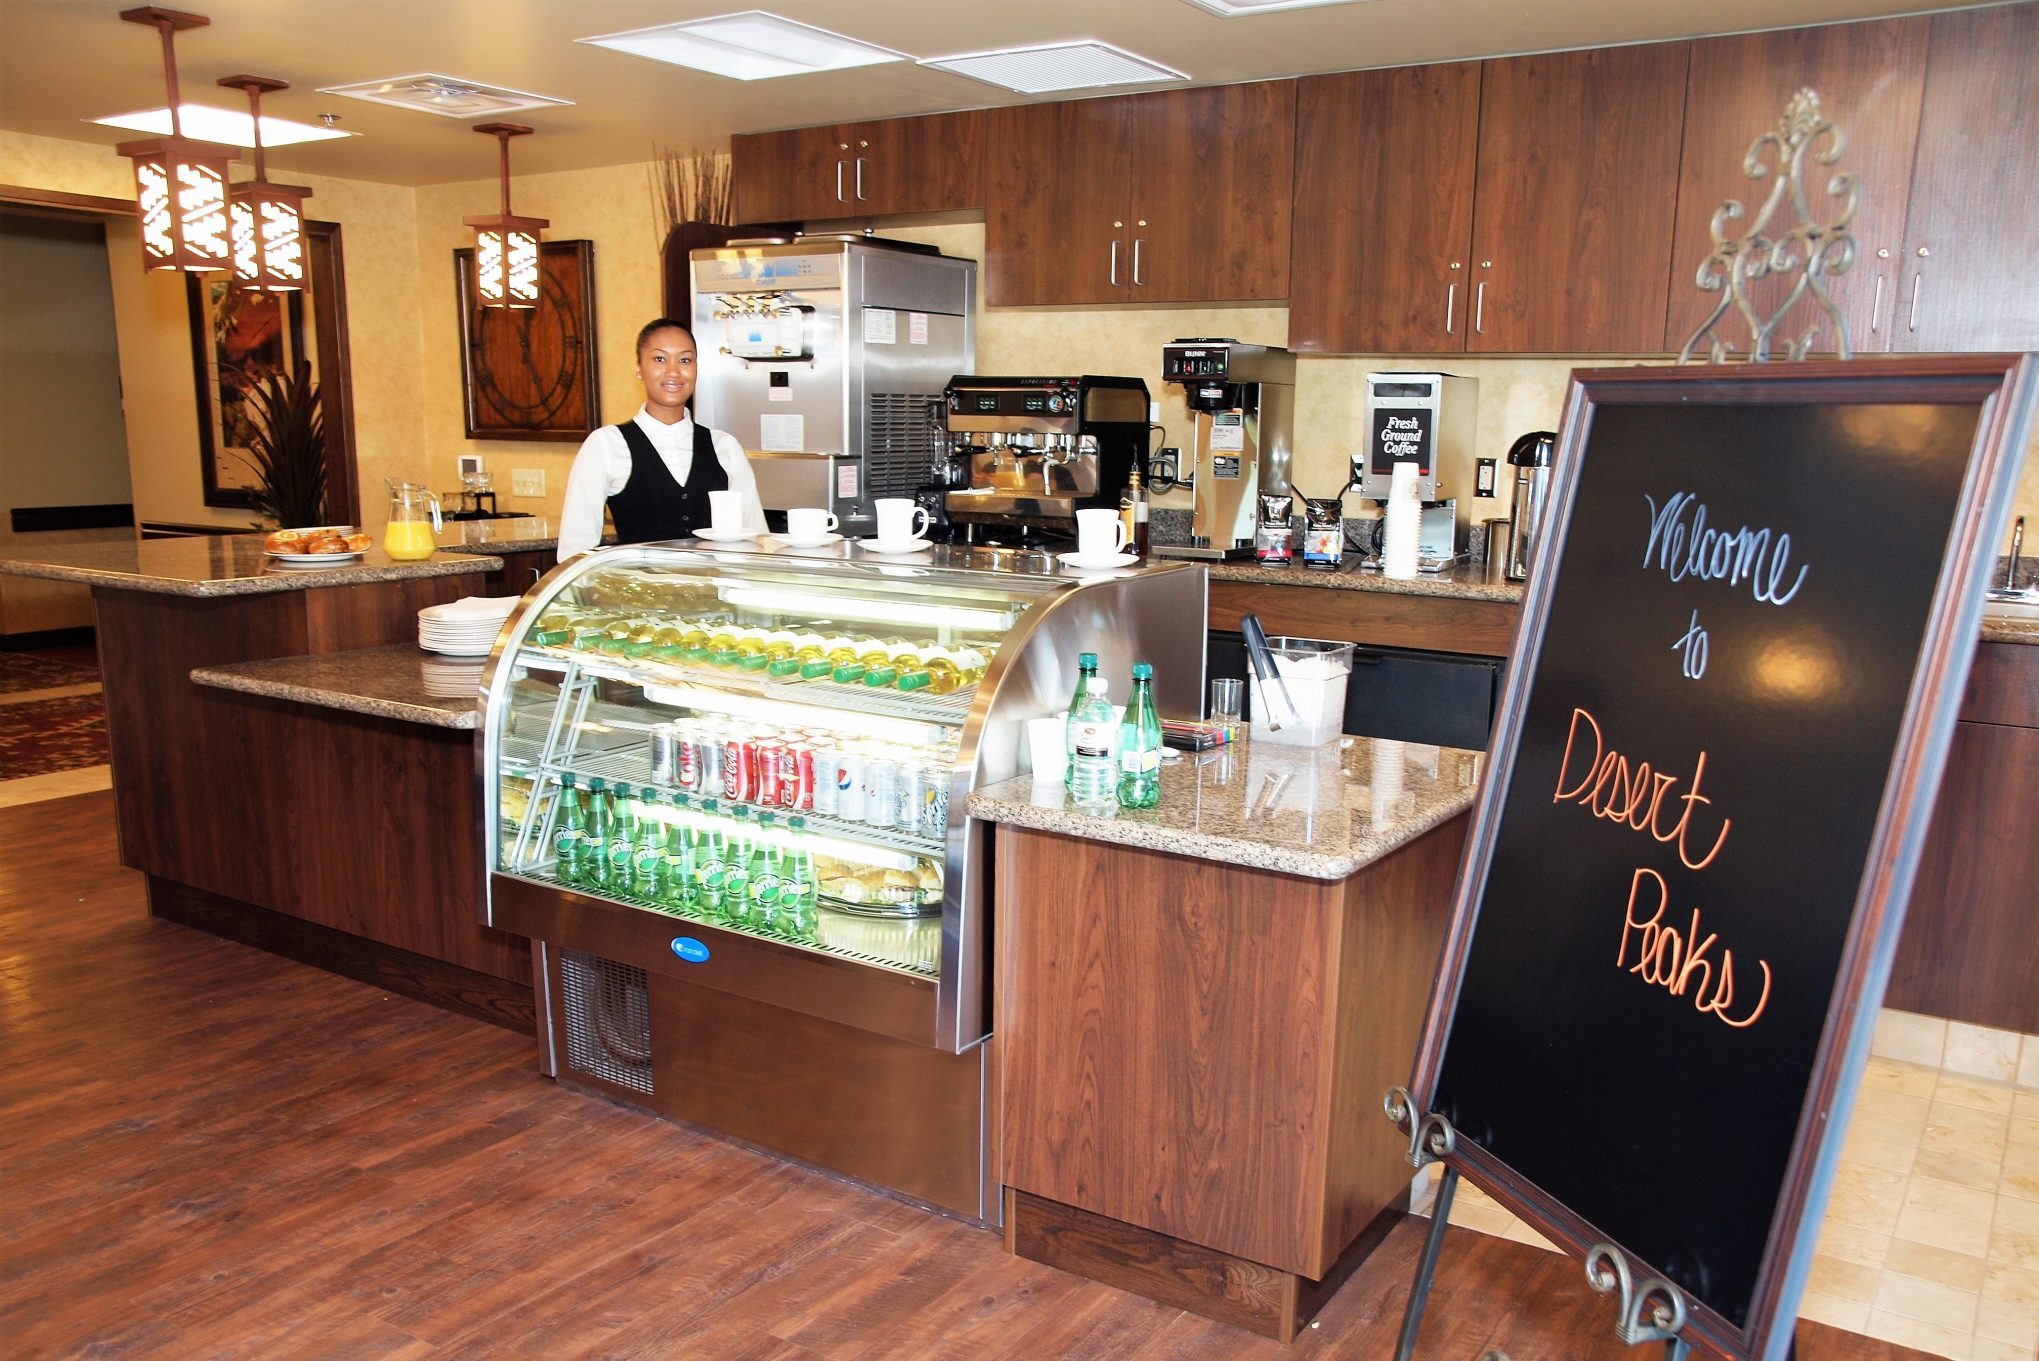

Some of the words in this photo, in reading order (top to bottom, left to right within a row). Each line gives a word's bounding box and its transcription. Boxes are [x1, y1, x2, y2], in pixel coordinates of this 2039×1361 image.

[1381, 428, 1423, 442] Ground
[1383, 441, 1419, 457] Coffee
[1386, 416, 1419, 429] Fresh
[1643, 491, 1810, 605] Welcome
[1670, 609, 1708, 679] to
[1553, 708, 1730, 869] Desert
[1617, 868, 1771, 1027] Peaks
